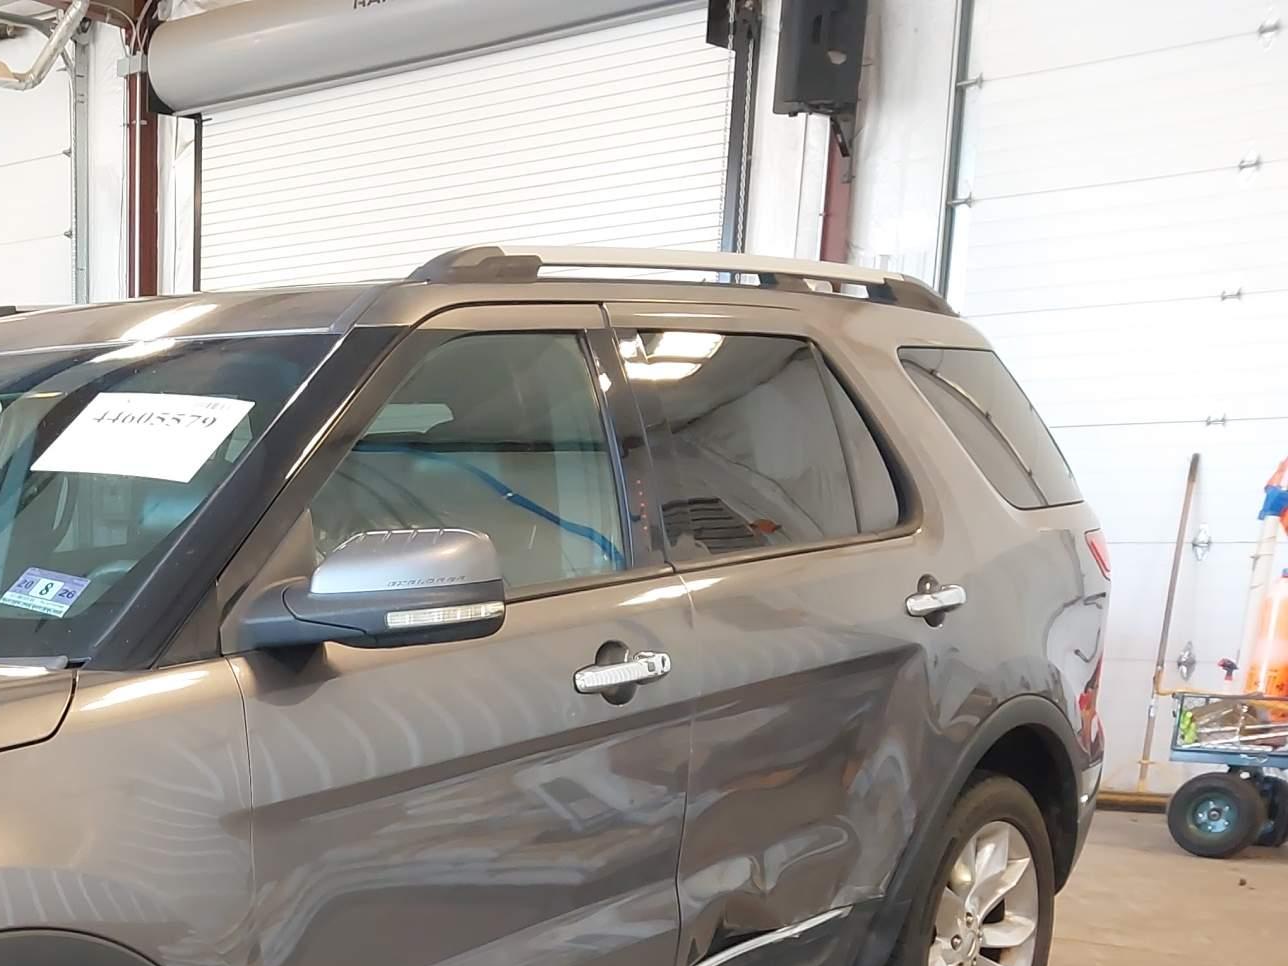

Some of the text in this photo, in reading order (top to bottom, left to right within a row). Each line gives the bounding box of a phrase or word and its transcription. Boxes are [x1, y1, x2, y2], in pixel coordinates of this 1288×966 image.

[93, 410, 217, 428] 44605579
[18, 580, 76, 599] 20 8 26
